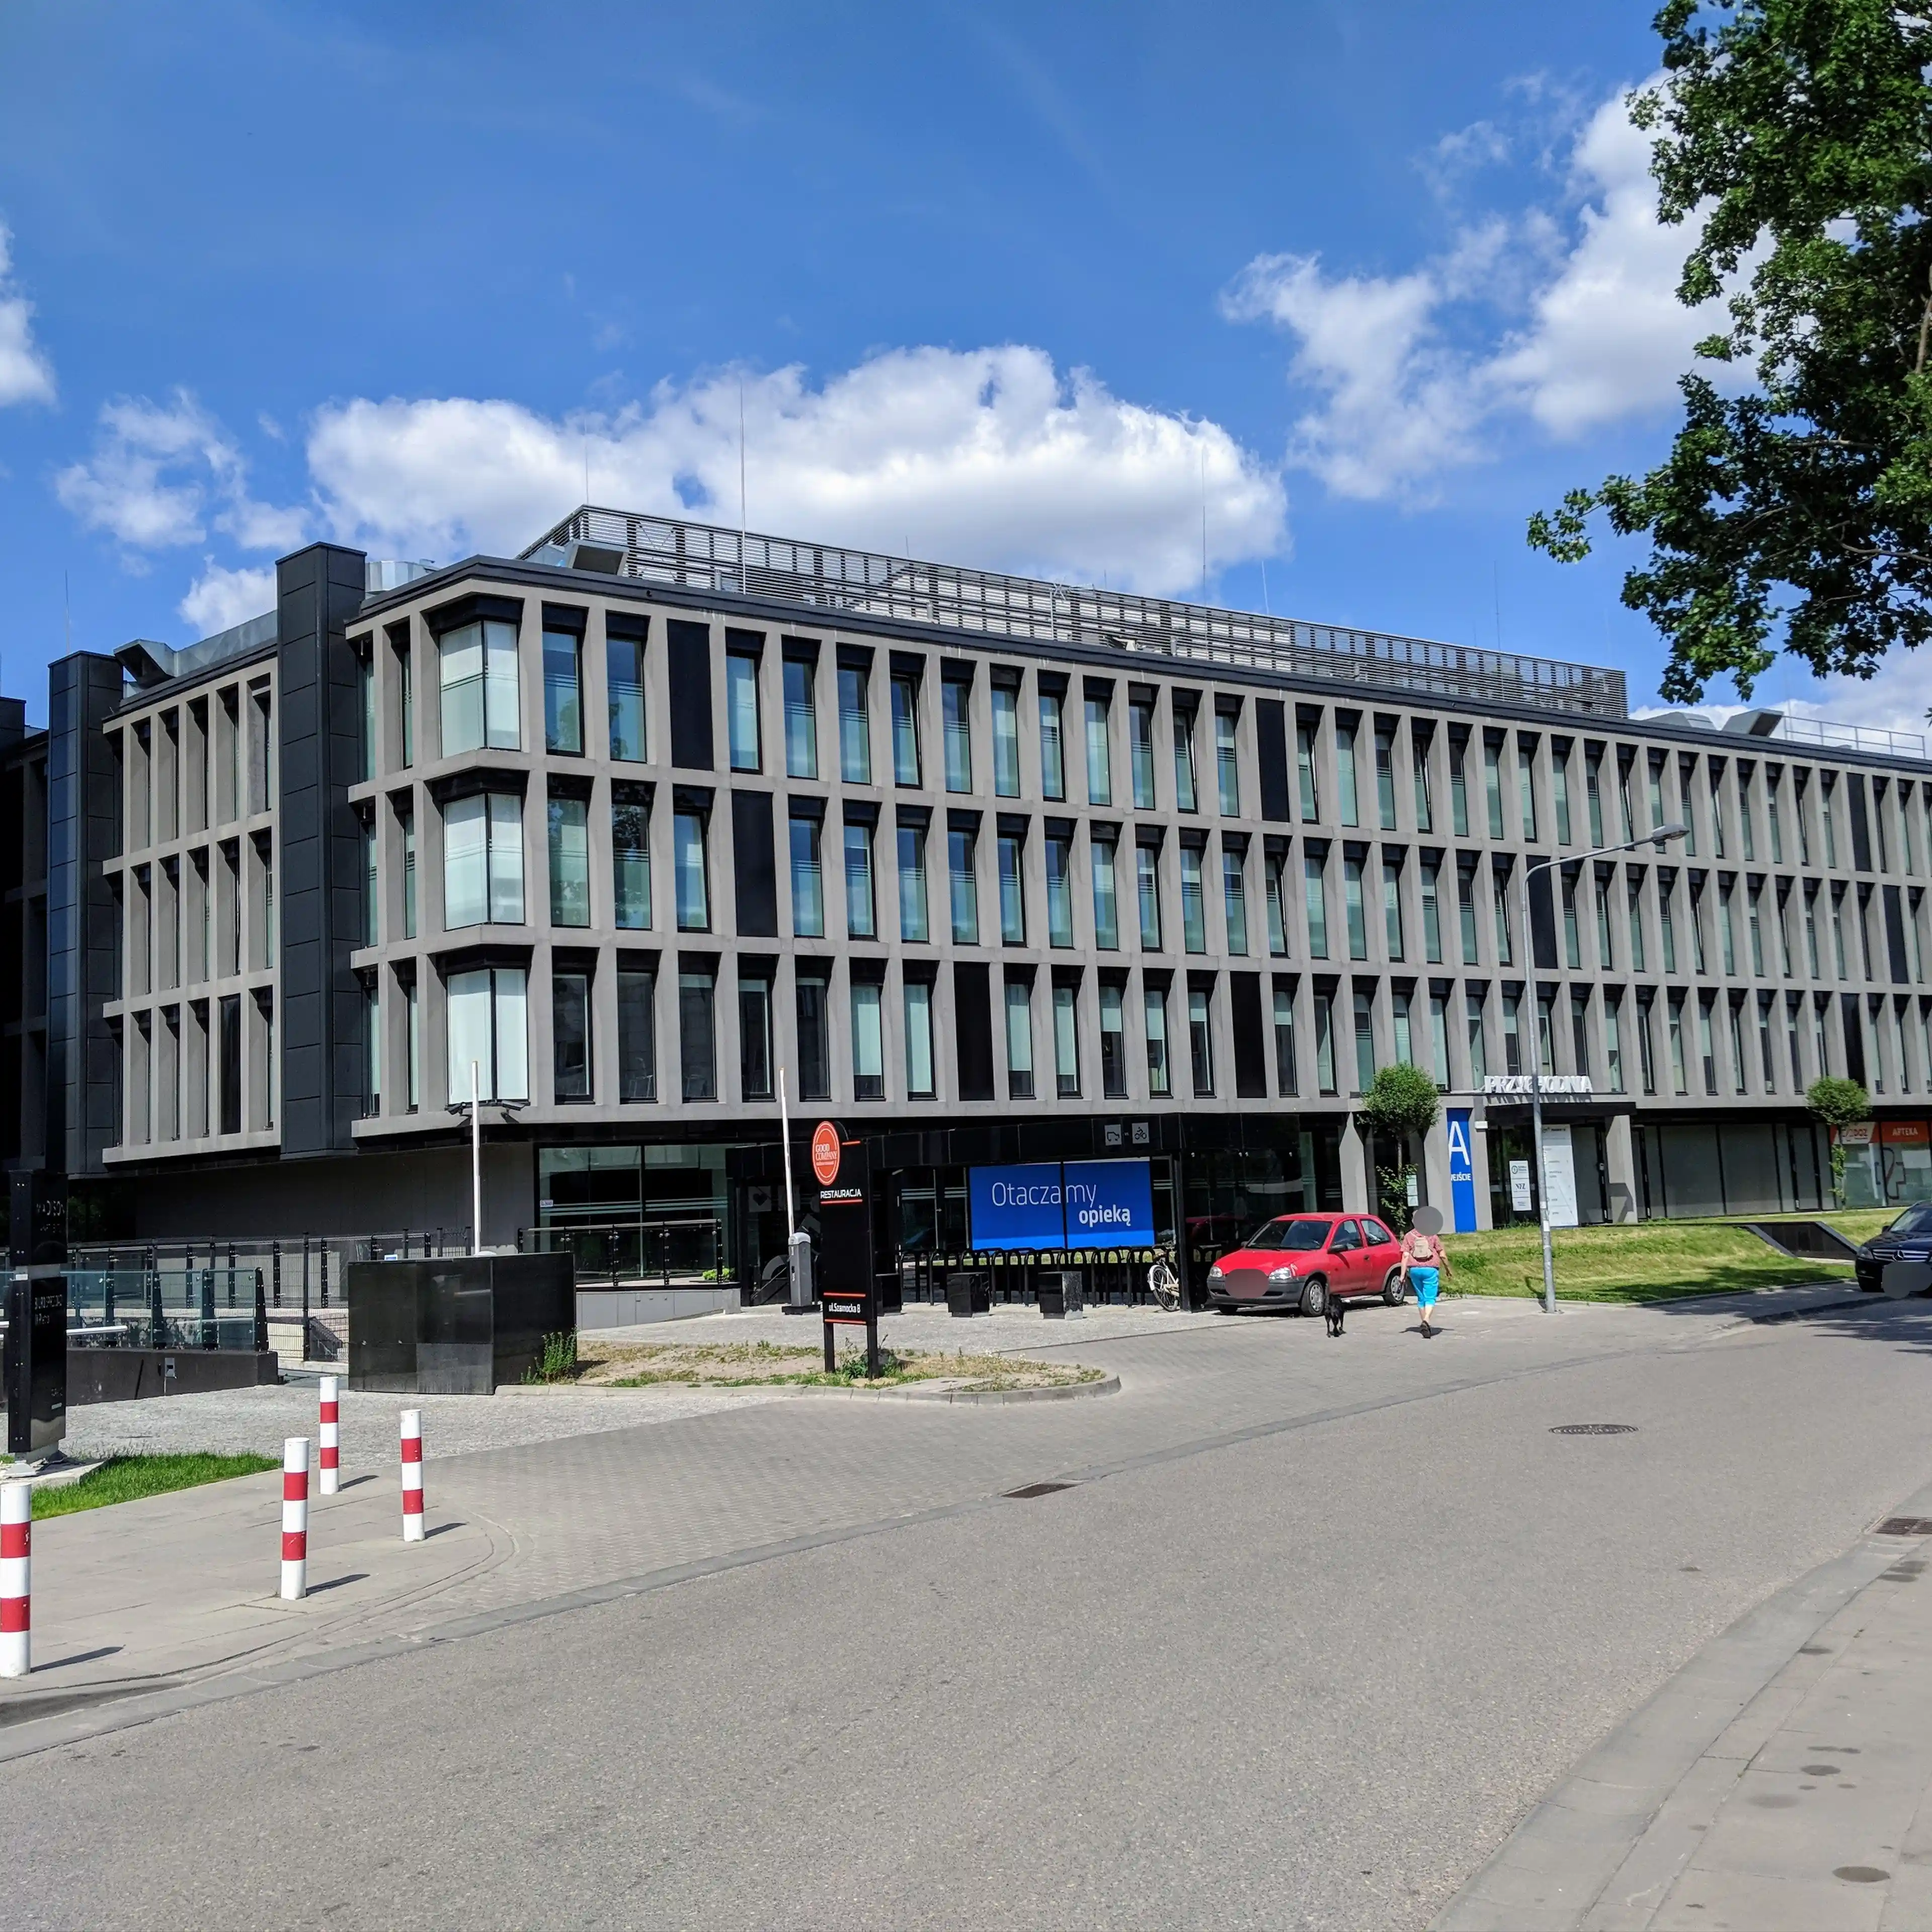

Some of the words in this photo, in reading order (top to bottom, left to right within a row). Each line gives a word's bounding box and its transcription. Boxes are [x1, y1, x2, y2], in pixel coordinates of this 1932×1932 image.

[1485, 1076, 1592, 1093] PRZYCHODNIA
[1892, 1128, 1918, 1136] APTEKA
[815, 1144, 830, 1152] GOOD
[1448, 1121, 1470, 1165] A
[815, 1151, 837, 1160] COMPANY
[820, 1188, 862, 1198] RESTAURACJA
[992, 1182, 1096, 1208] Otaczamy
[1079, 1204, 1131, 1228] opieką
